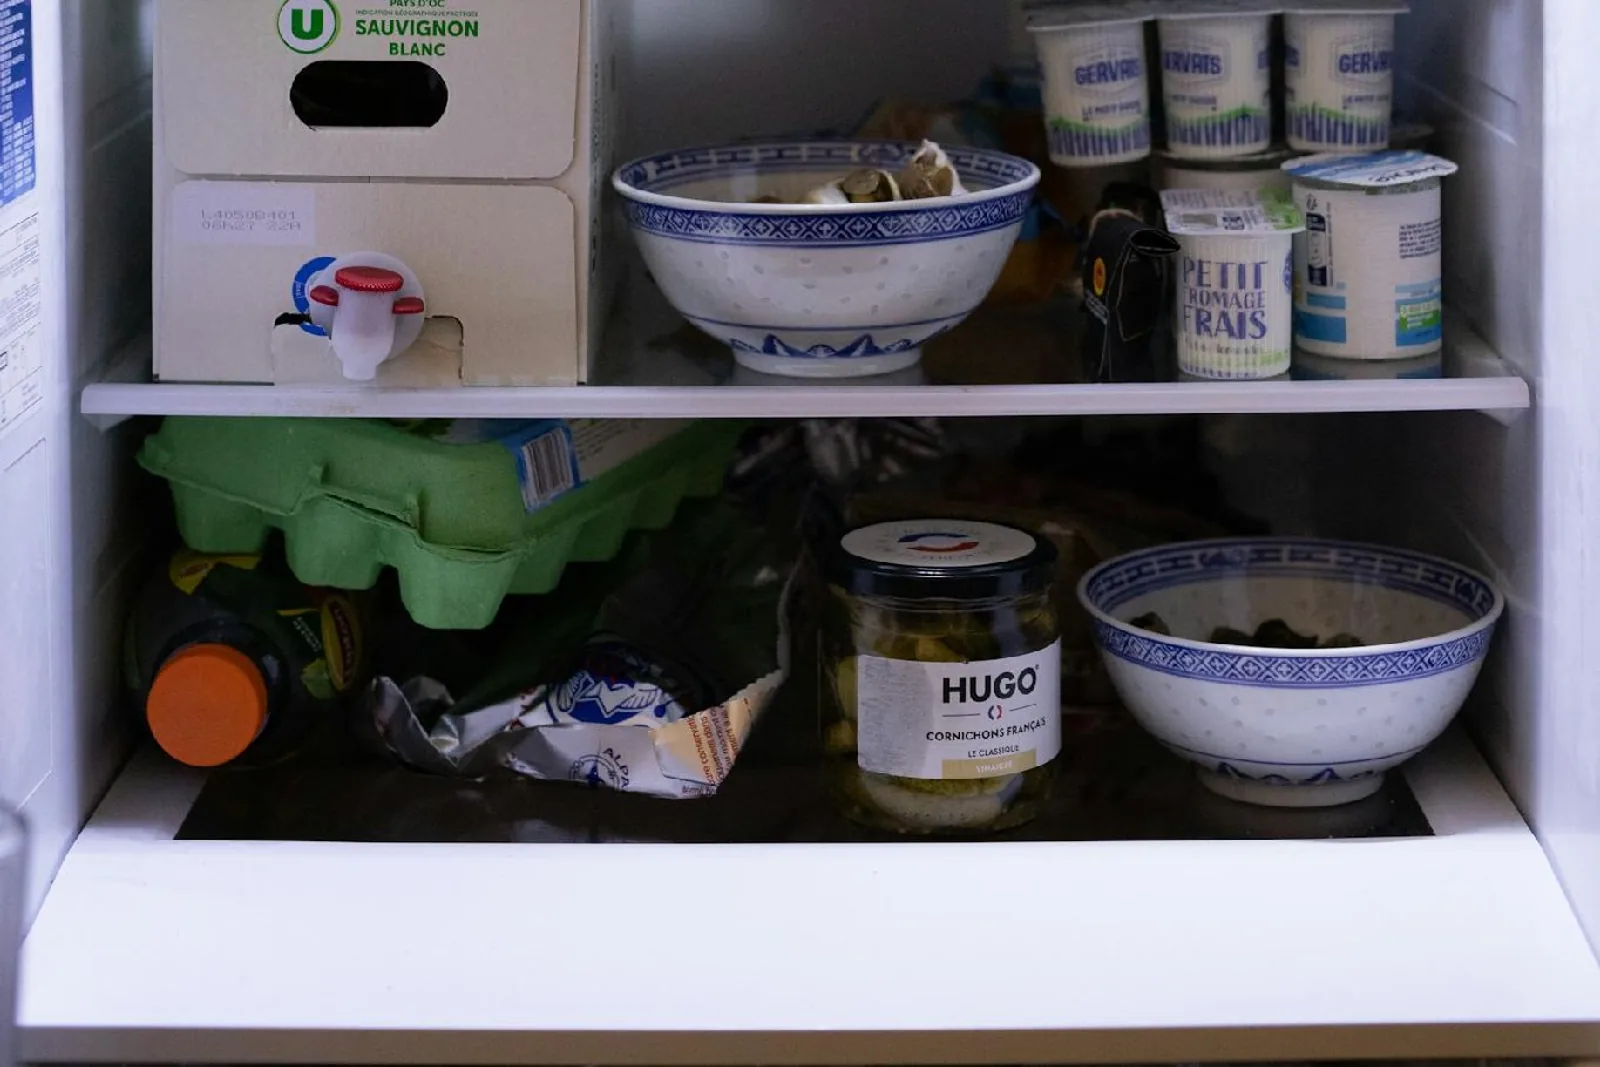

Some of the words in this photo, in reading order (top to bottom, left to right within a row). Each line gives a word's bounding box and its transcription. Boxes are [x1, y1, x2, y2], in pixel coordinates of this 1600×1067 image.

[291, 9, 324, 40] U
[355, 19, 479, 37] SAUVIGNON
[389, 42, 446, 56] BLANC
[1182, 256, 1269, 290] PETIT
[1183, 287, 1266, 309] FROMAGE
[1183, 305, 1268, 340] FRAIS
[942, 666, 1037, 704] HUGO
[925, 727, 1005, 742] CORNICHONS
[967, 750, 977, 758] LE
[978, 744, 1020, 757] CLASSIQUE
